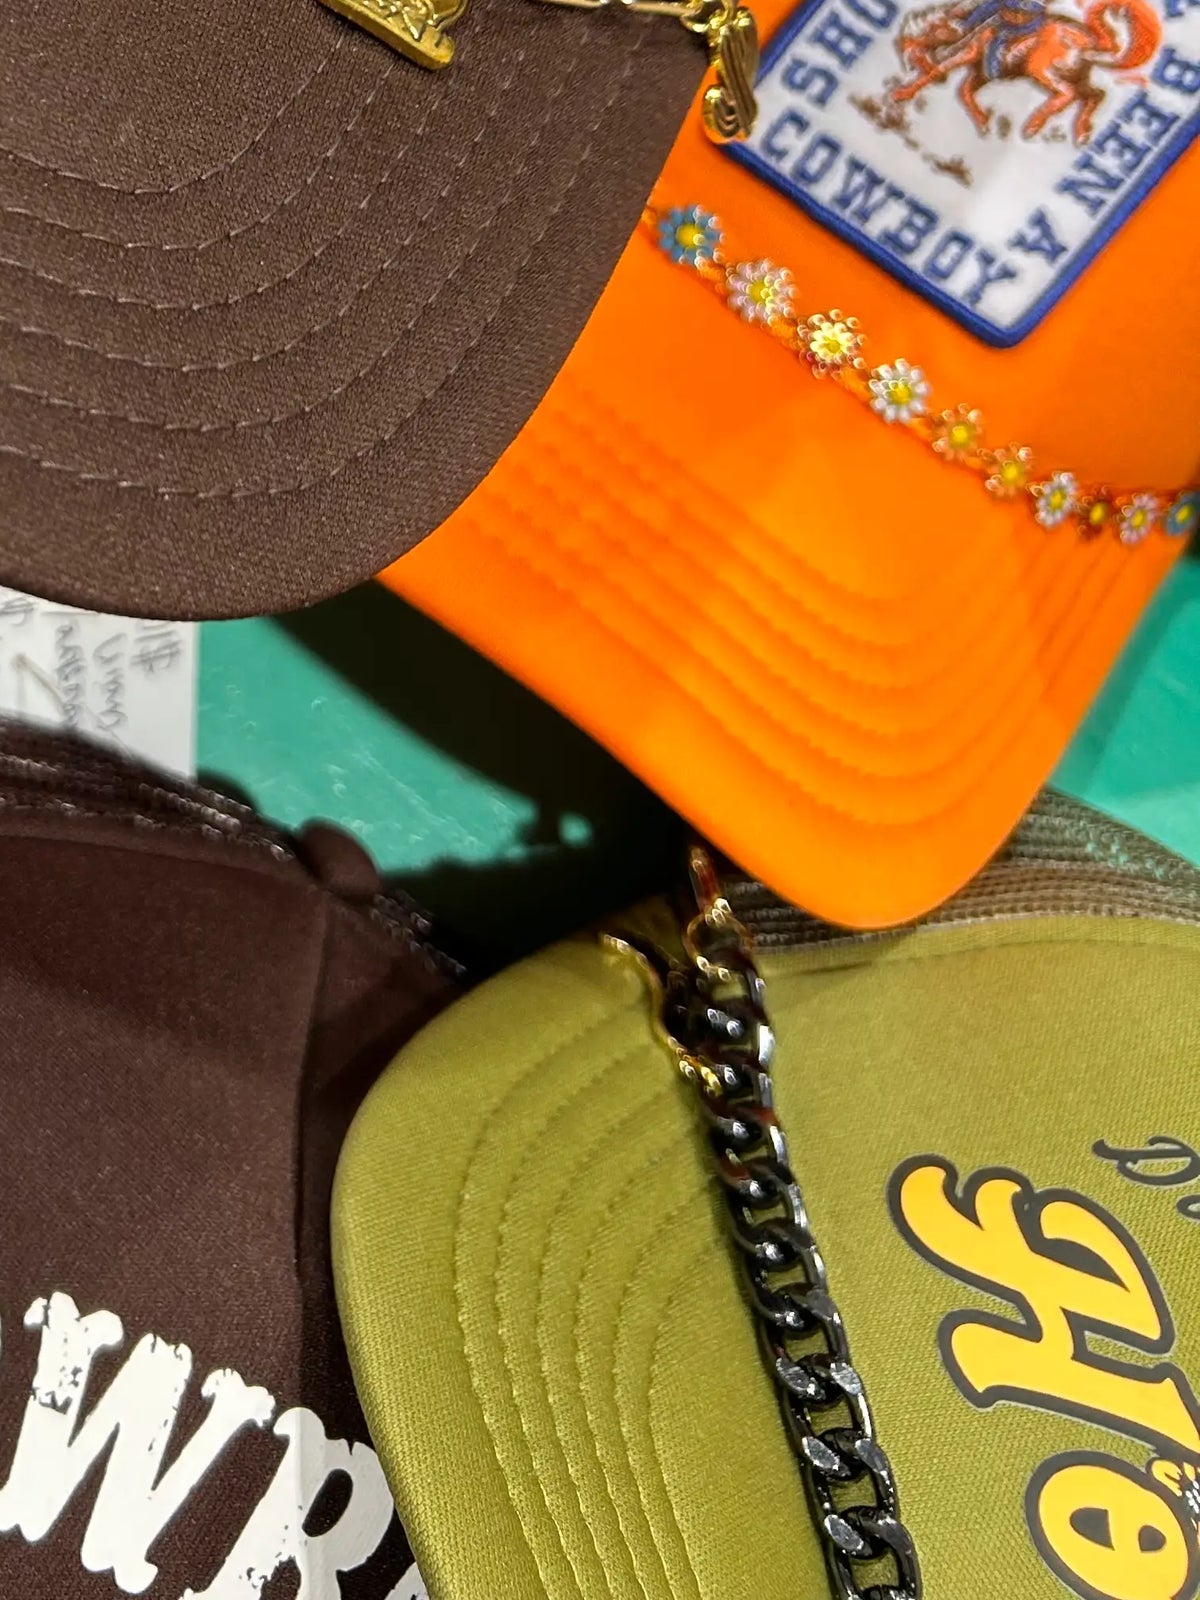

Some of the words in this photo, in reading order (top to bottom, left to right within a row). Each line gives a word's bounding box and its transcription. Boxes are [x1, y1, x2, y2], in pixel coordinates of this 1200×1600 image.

[760, 108, 1016, 305] COWBOY
[1054, 46, 1200, 218] BEEN
[1008, 206, 1068, 266] A
